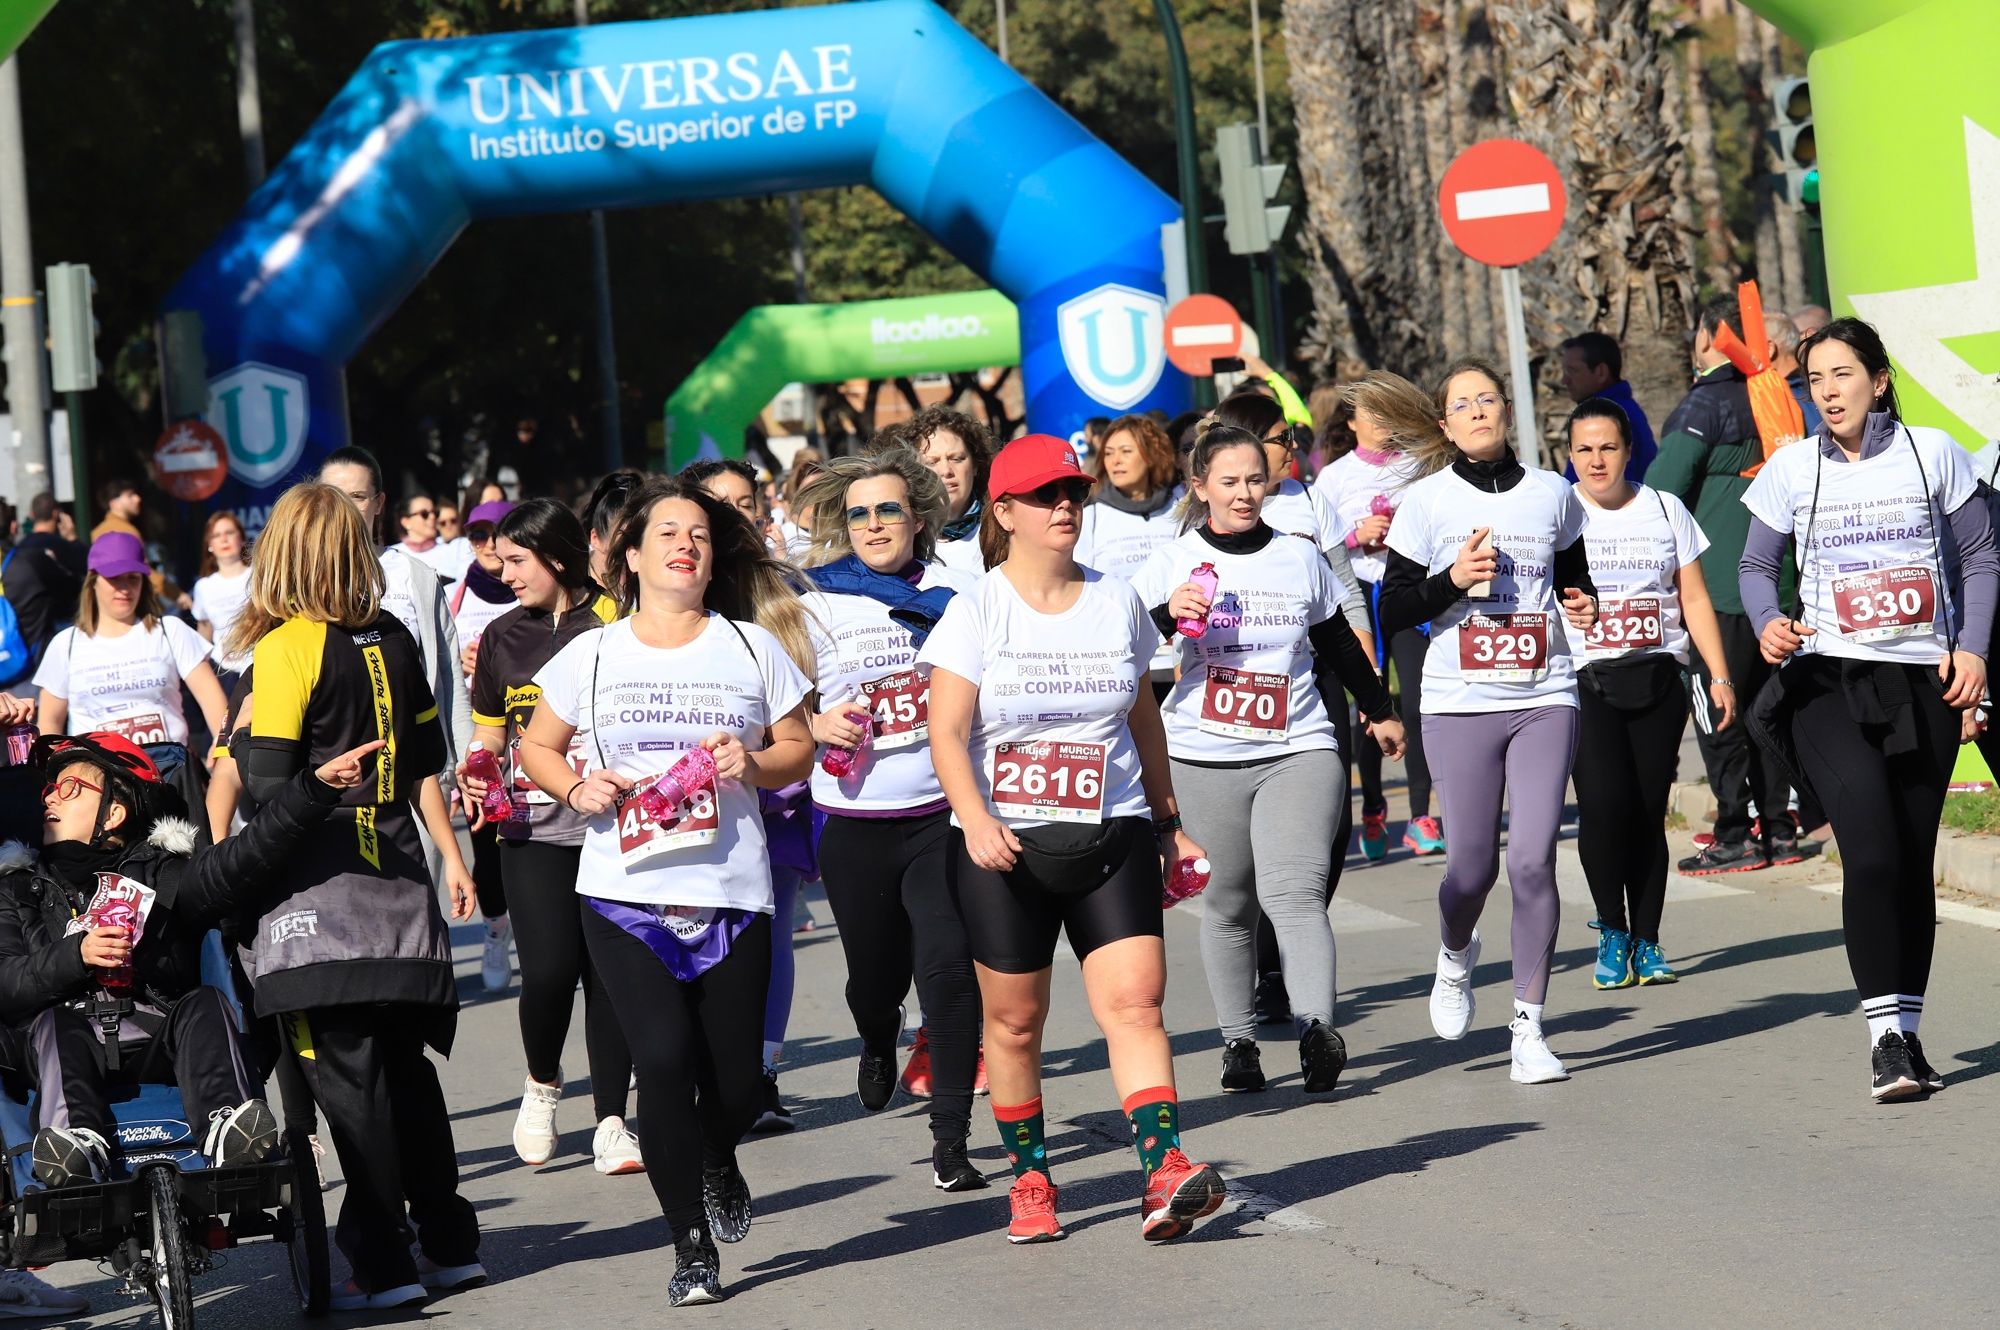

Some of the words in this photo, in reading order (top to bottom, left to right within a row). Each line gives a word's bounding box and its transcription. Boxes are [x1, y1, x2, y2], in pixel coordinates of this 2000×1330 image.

[464, 44, 857, 125] UNIVERSAE
[469, 127, 606, 161] Instituto
[614, 110, 755, 152] Superior
[762, 105, 806, 135] de
[815, 100, 857, 129] FP
[1079, 306, 1149, 387] U
[218, 384, 290, 465] U
[1851, 502, 1863, 510] DE
[1864, 500, 1875, 508] LA
[1876, 497, 1903, 507] MUJER
[1843, 510, 1863, 528] MÍ
[1865, 514, 1876, 525] Y
[1877, 511, 1906, 525] POR
[1513, 535, 1536, 543] MUJER
[1822, 525, 1922, 548] COMPAÑERAS
[1513, 548, 1536, 560] POR
[1494, 561, 1547, 577] PAÑERAS
[1587, 557, 1665, 571] OMPAÑERAS
[1889, 569, 1927, 579] MURCIA
[1239, 589, 1249, 597] DE
[1233, 597, 1251, 612] MÍ
[1263, 601, 1288, 612] POR
[1629, 600, 1657, 608] MURCIA
[1850, 588, 1922, 622] 330
[1211, 612, 1305, 630] COMPAÑERAS
[1476, 618, 1507, 633] mujer
[1512, 615, 1543, 623] MURCIA
[1587, 615, 1659, 643] 3329
[351, 630, 382, 646] NIEVES
[837, 630, 854, 641] VIII
[854, 625, 893, 636] CARRERA
[856, 640, 885, 653] POR
[887, 632, 909, 649] MÍ
[1473, 633, 1537, 662] 329
[997, 650, 1015, 659] VIII
[1016, 652, 1054, 660] CARRERA
[1055, 652, 1067, 660] DE
[1081, 651, 1108, 659] MUJER
[368, 651, 386, 699] RUEDAS
[1018, 664, 1046, 676] POR
[1048, 661, 1070, 676] MÍ
[1070, 664, 1082, 676] Y
[1084, 663, 1115, 675] POR
[615, 682, 659, 690] CARRERA
[661, 682, 675, 690] DE
[676, 682, 689, 690] LA
[691, 682, 722, 690] MUJER
[881, 676, 911, 692] mujer
[994, 683, 1021, 697] MIS
[1024, 677, 1134, 694] COMPAÑERAS
[1222, 672, 1249, 688] mujer
[1254, 675, 1286, 685] MURCIA
[614, 693, 645, 706] POR
[649, 690, 674, 705] MÍ
[677, 694, 689, 706] Y
[692, 694, 724, 708] POR
[1214, 687, 1275, 720] 070
[619, 707, 746, 729] COMPAÑERAS
[1016, 744, 1052, 761] mujer
[1059, 745, 1101, 757] MURCIA
[995, 761, 1100, 799] 2616
[1032, 797, 1060, 806] CATICA
[91, 875, 109, 910] MURCIA
[270, 914, 318, 945] UPCT
[676, 918, 706, 937] MARZO
[113, 1125, 163, 1137] Advance
[124, 1131, 171, 1142] Mobility
